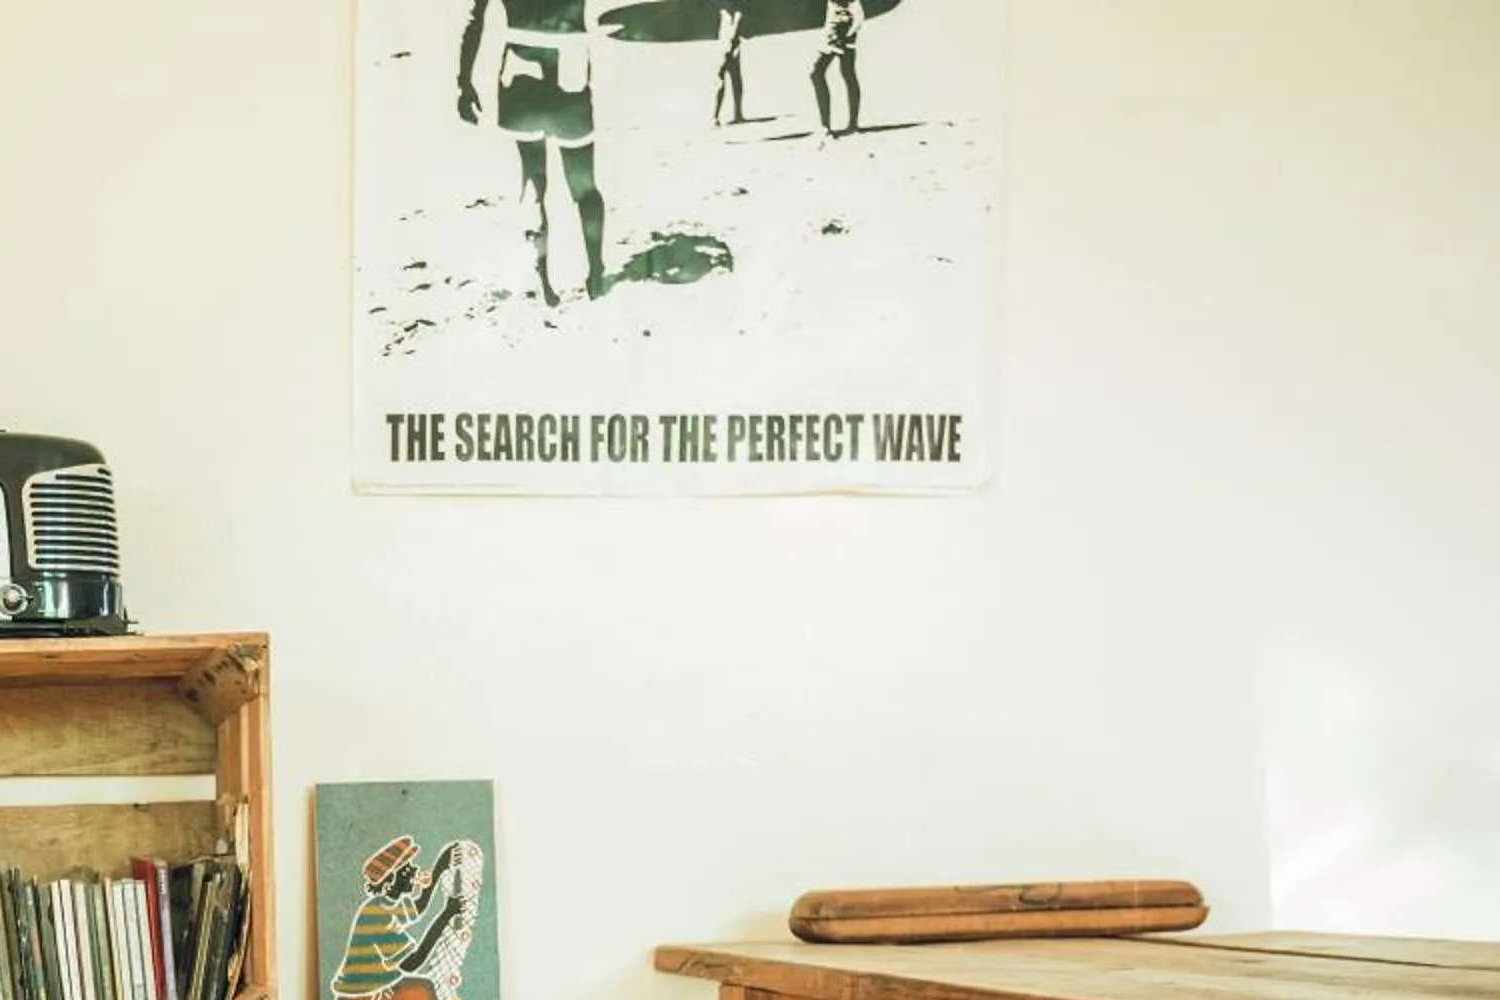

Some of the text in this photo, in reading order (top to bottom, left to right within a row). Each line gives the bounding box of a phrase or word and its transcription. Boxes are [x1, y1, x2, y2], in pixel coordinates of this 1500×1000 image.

[386, 412, 962, 462] THE SEARCH FOR THE PERFECT WAVE
